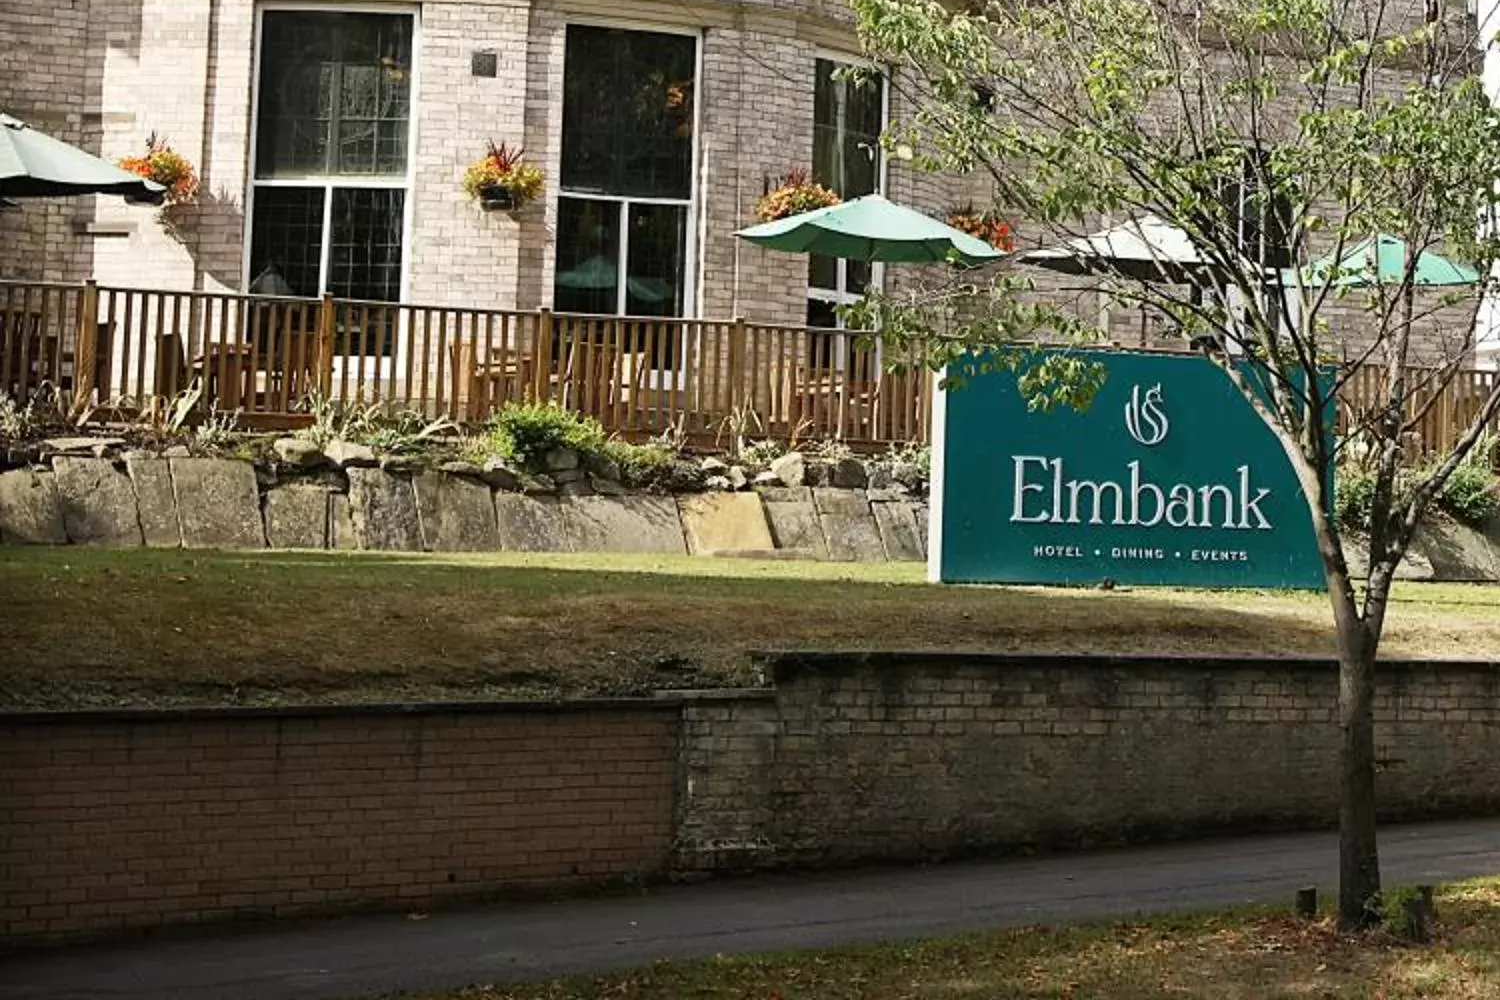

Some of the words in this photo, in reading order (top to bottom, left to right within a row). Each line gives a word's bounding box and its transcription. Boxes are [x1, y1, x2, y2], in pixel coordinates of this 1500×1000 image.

[1009, 455, 1273, 529] Elmbank
[1033, 545, 1084, 557] HOTEL
[1111, 547, 1165, 559] DINING
[1191, 549, 1248, 561] EVENTS
